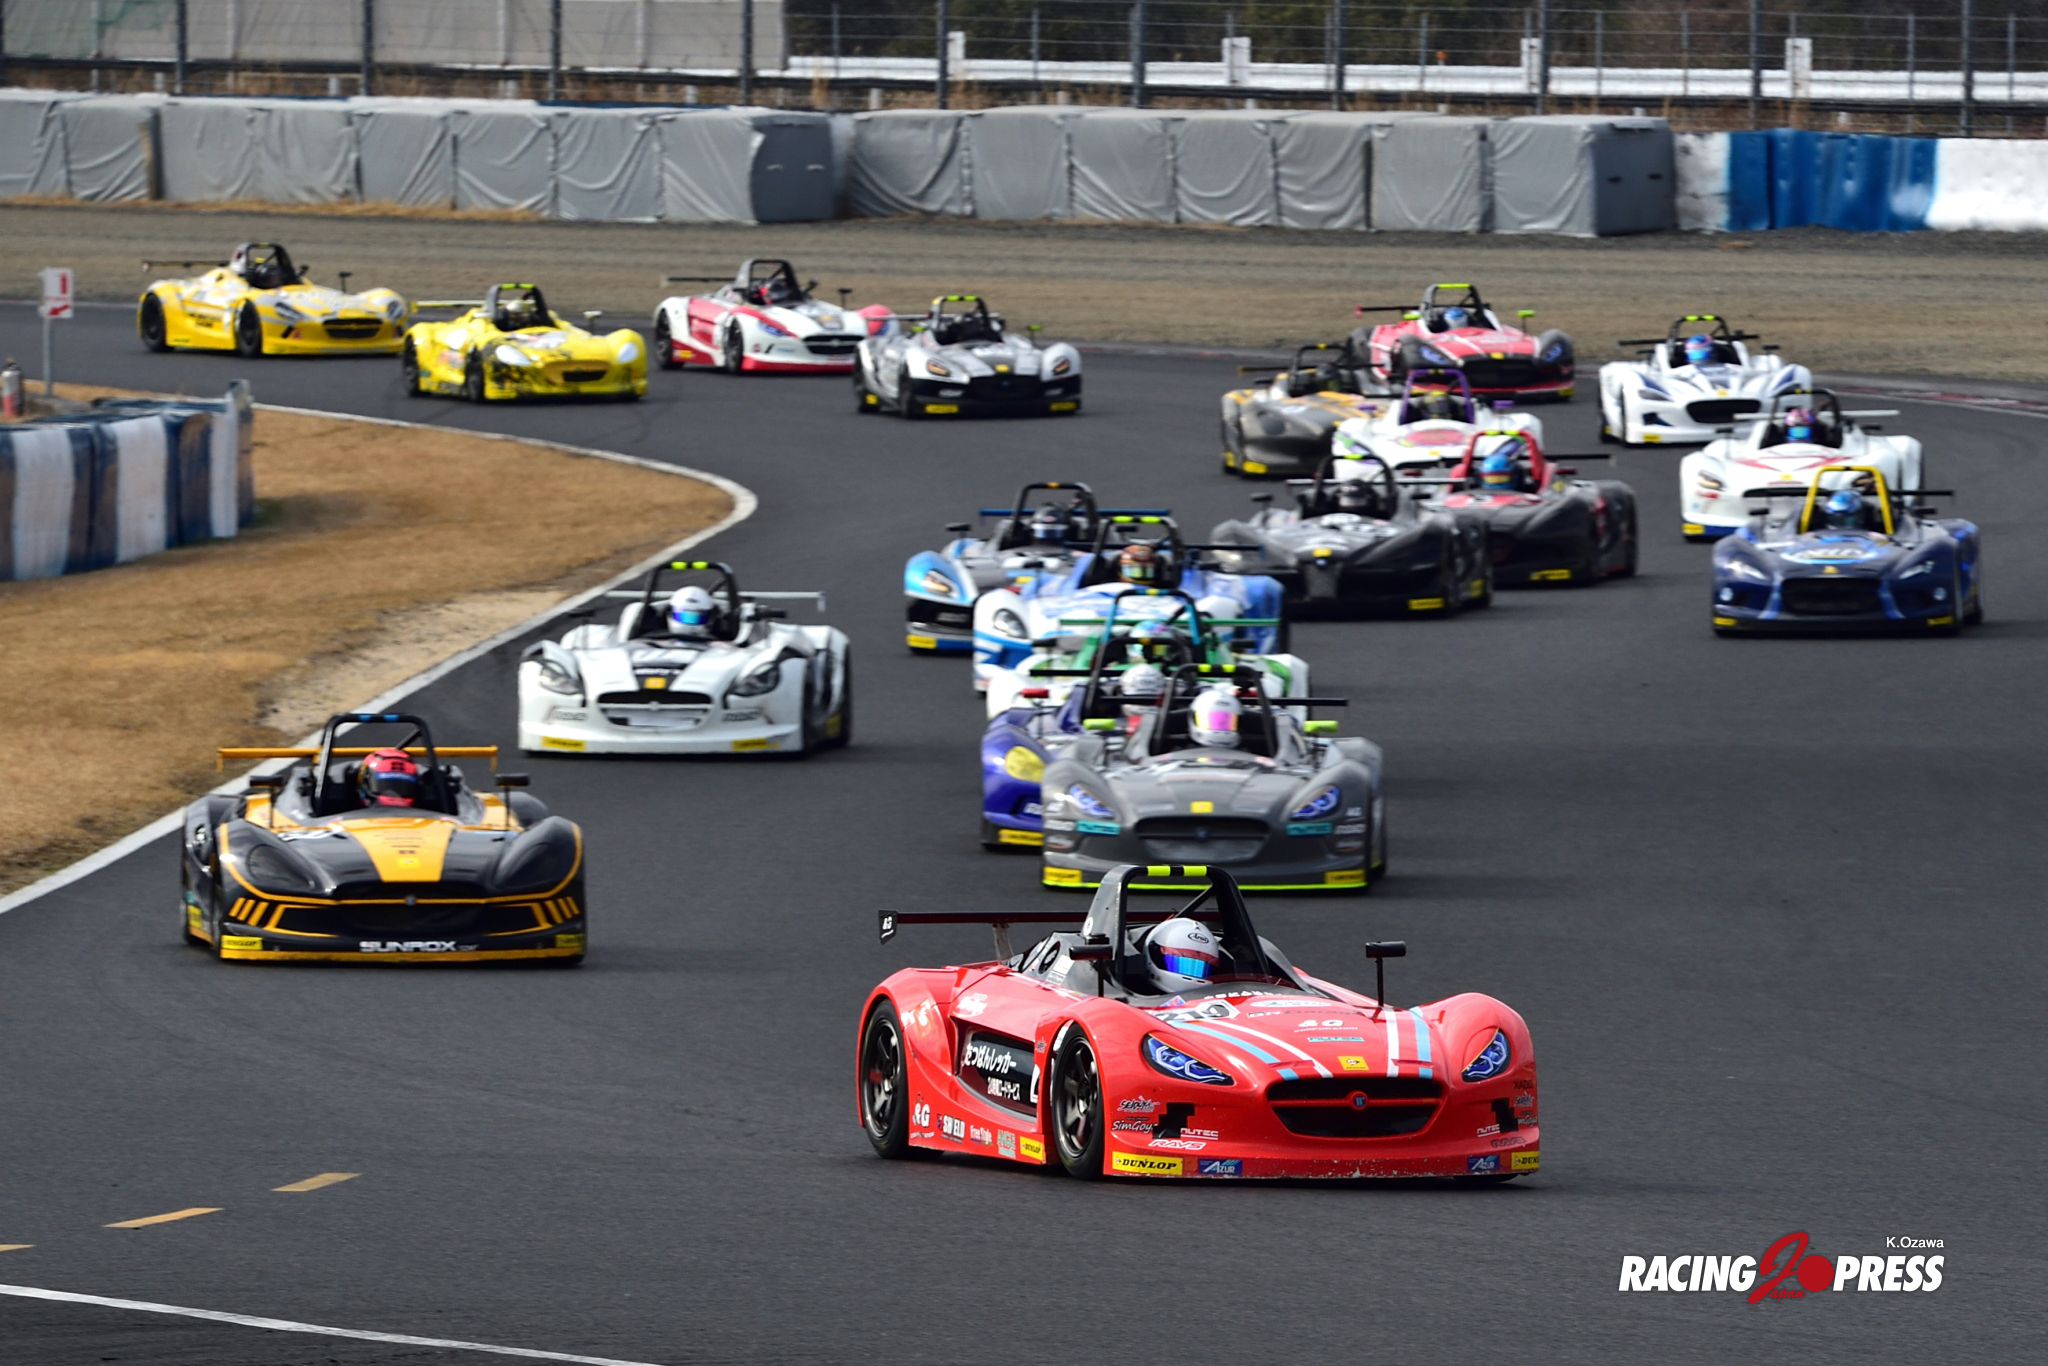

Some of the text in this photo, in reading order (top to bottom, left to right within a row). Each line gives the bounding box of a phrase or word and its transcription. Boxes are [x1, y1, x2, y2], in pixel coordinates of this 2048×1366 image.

[359, 940, 457, 953] SUNROX
[1023, 1143, 1041, 1154] DUNLOP
[1148, 1139, 1207, 1150] RAYS
[1122, 1157, 1177, 1170] DUNLOP
